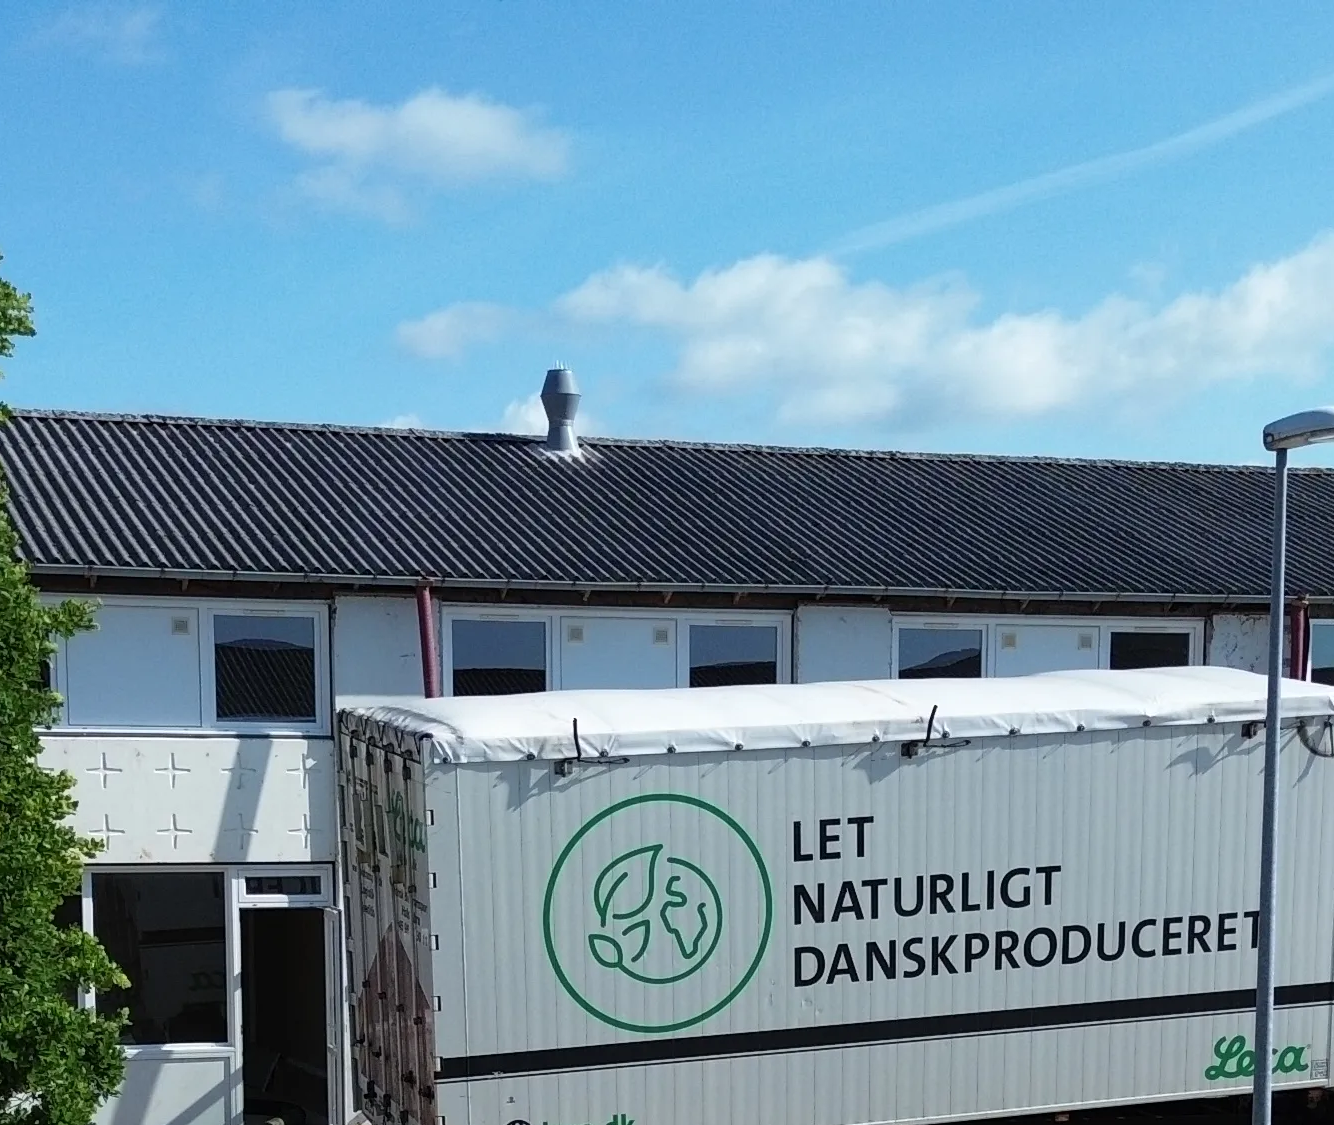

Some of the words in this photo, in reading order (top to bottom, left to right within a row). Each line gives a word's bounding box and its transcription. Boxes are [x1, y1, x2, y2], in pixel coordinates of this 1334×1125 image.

[793, 815, 875, 863] LET
[793, 865, 1062, 925] NATURLIGT
[793, 910, 1262, 988] DANSKPRODUCERET
[1205, 1034, 1309, 1081] Lea
